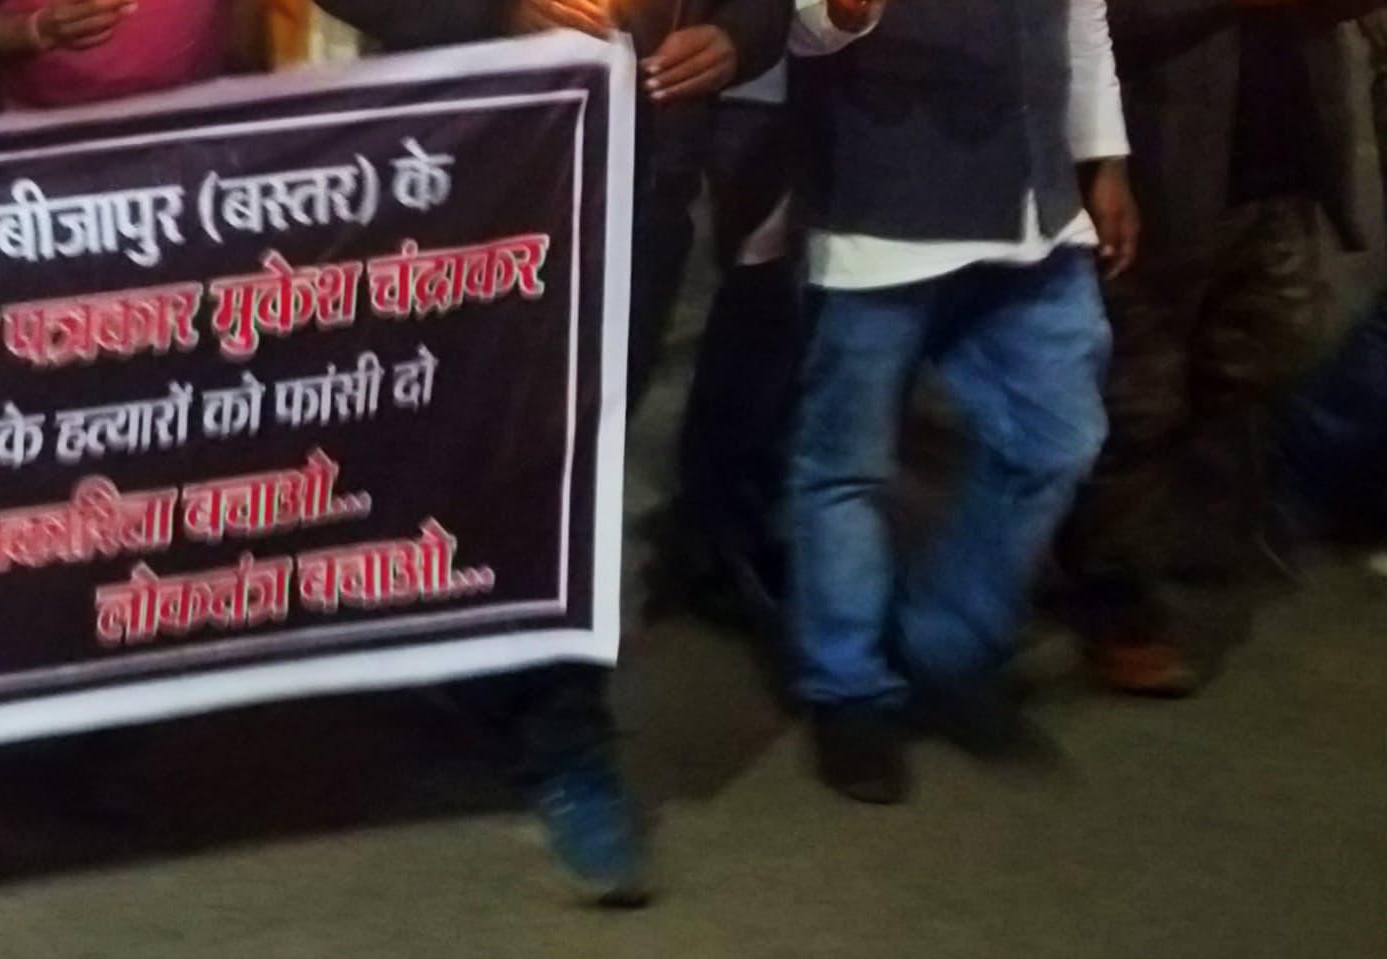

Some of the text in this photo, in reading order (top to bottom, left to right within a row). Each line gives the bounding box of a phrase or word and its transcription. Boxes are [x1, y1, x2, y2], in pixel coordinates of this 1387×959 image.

[199, 154, 379, 241] (बस्तर)
[389, 138, 455, 213] के
[4, 281, 202, 365] पत्रकार
[211, 247, 362, 359] मुकेश
[368, 234, 550, 318] चंद्राकर
[56, 380, 193, 460] हत्यारों
[202, 371, 267, 438] को
[275, 352, 385, 426] फांसी
[392, 345, 438, 411] दो
[96, 551, 292, 642] लोकतंत्र
